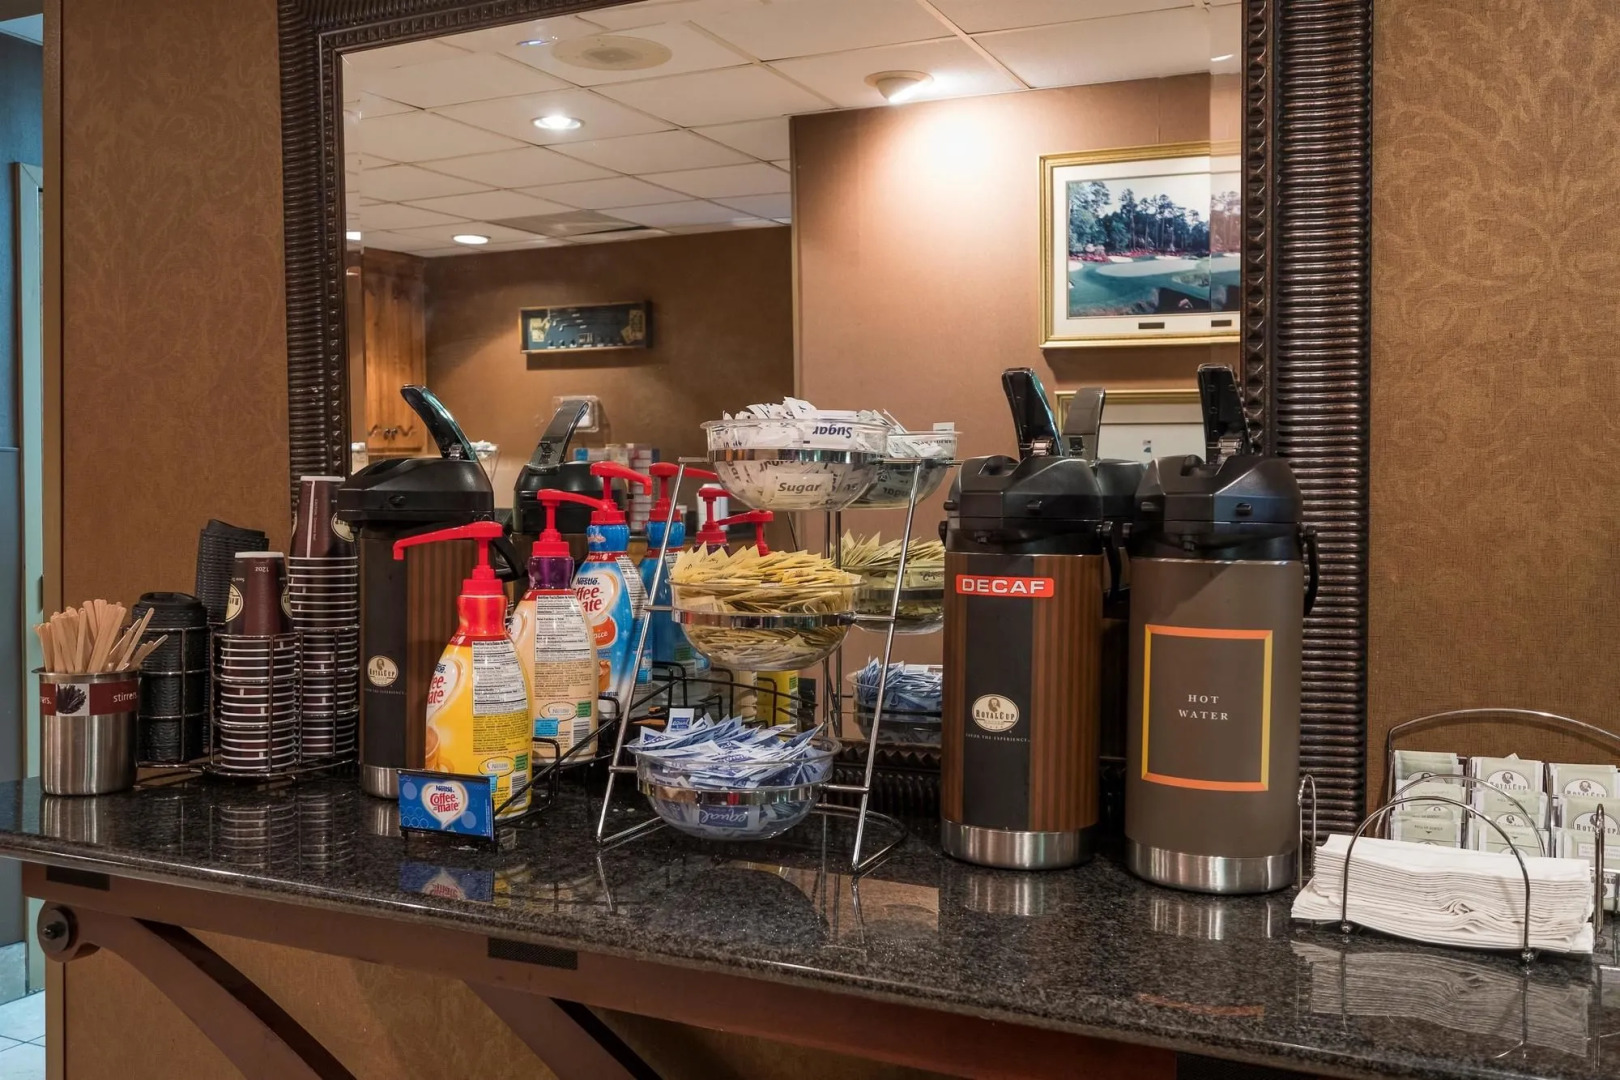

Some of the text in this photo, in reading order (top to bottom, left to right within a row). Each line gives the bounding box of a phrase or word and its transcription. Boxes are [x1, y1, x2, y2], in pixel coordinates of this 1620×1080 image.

[812, 425, 852, 438] Sugar
[777, 482, 822, 494] Sugar
[962, 578, 1045, 594] DECAF
[576, 586, 604, 601] ffee-
[582, 598, 602, 613] ate
[428, 690, 444, 705] ate
[1187, 694, 1219, 704] HOT
[1178, 708, 1229, 721] WATER
[430, 792, 459, 806] Coffee-
[437, 802, 459, 813] mate
[699, 808, 747, 824] equal
